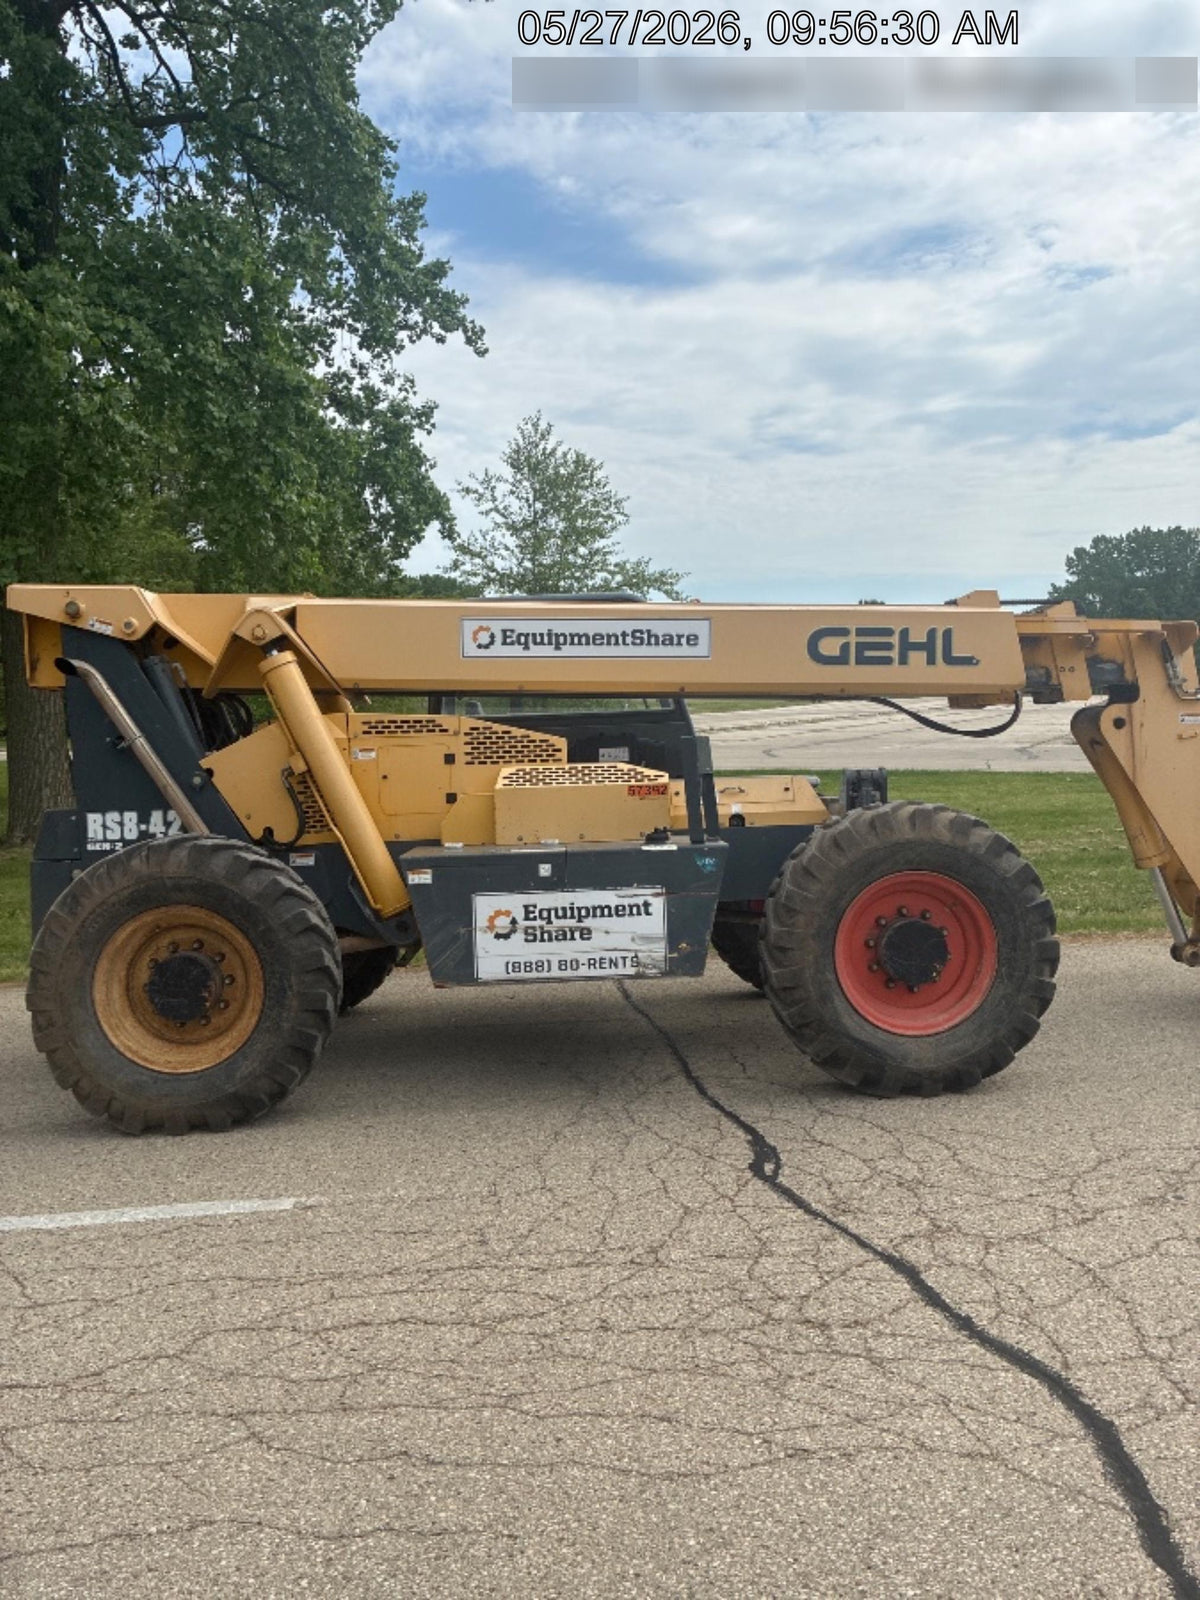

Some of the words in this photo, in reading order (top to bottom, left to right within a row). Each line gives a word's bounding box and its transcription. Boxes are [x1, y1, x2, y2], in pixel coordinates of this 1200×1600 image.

[500, 628, 700, 650] EquipmentShare
[806, 626, 980, 666] GEHL
[522, 899, 653, 924] Equipment
[523, 925, 593, 943] Share
